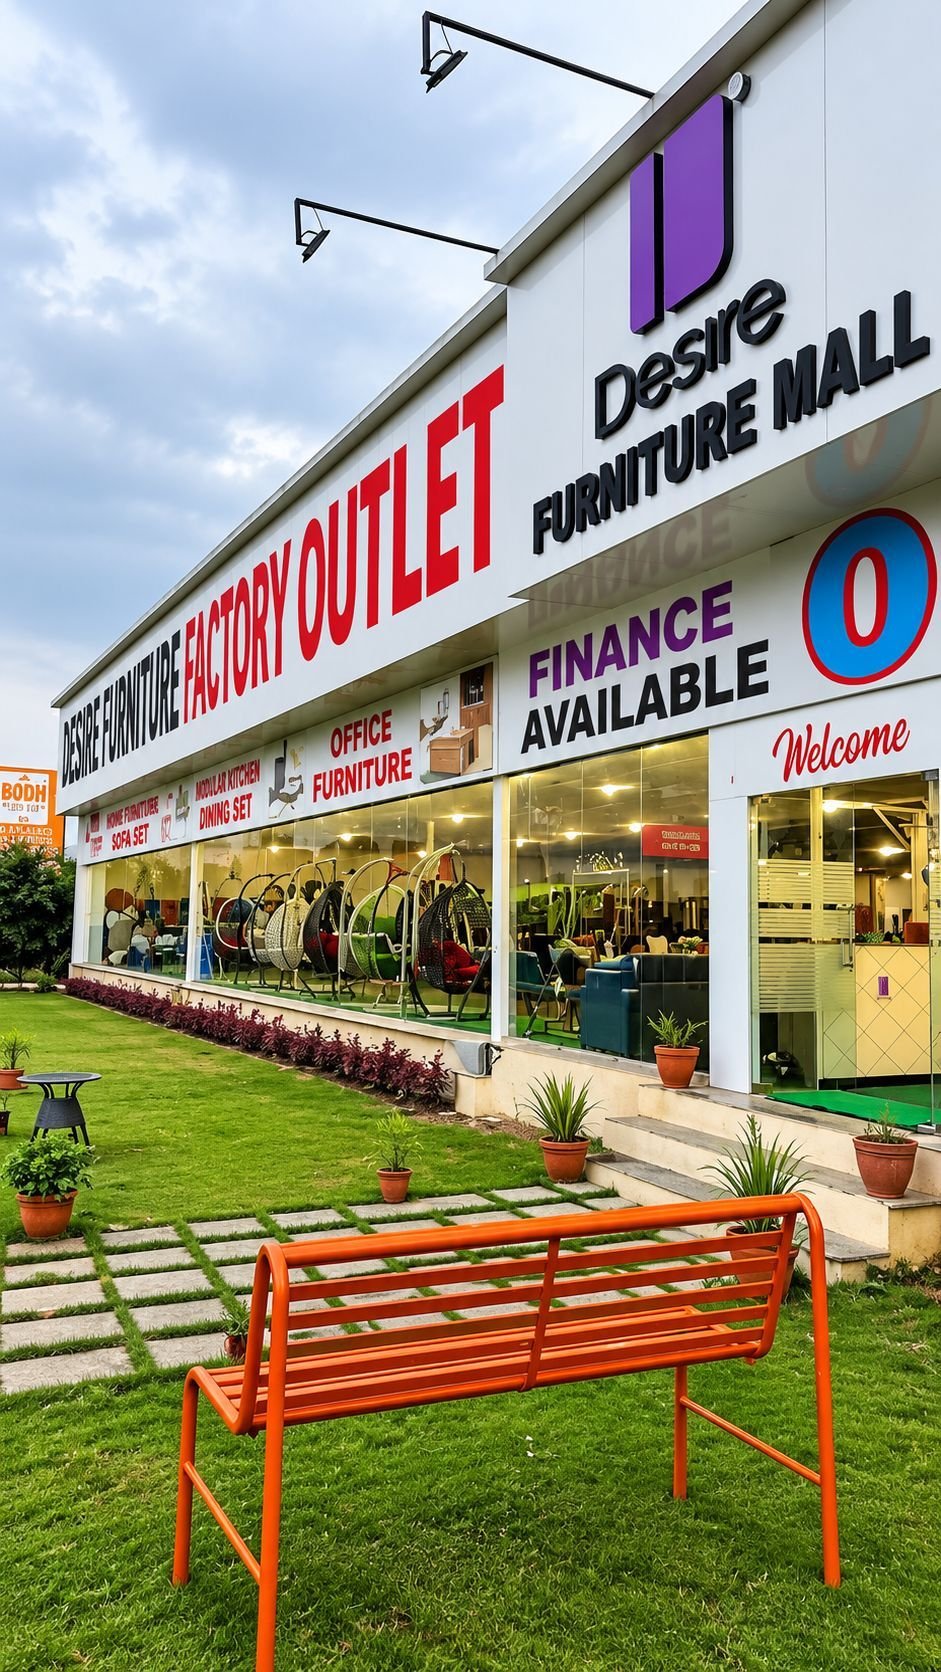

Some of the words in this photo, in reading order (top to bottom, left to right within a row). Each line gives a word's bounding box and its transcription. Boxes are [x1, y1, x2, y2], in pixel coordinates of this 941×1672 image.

[595, 278, 787, 440] Desire
[532, 377, 758, 555] FURNITURE
[773, 289, 931, 430] MALL
[61, 694, 101, 788] DESIRE
[102, 628, 181, 768] FURNITURE
[183, 538, 292, 725] FACTORY
[297, 363, 504, 662] OUTLET
[528, 580, 733, 698] FINANCE
[520, 638, 769, 754] AVAILABLE
[330, 709, 392, 758] OFFICE
[772, 718, 911, 783] Welcome
[1, 781, 47, 803] BODH
[227, 758, 261, 792] KITCHEN
[312, 747, 413, 803] FURNITURE
[112, 829, 132, 851] SOFA
[133, 823, 149, 846] SET
[199, 800, 231, 830] DINING
[232, 792, 253, 822] SET
